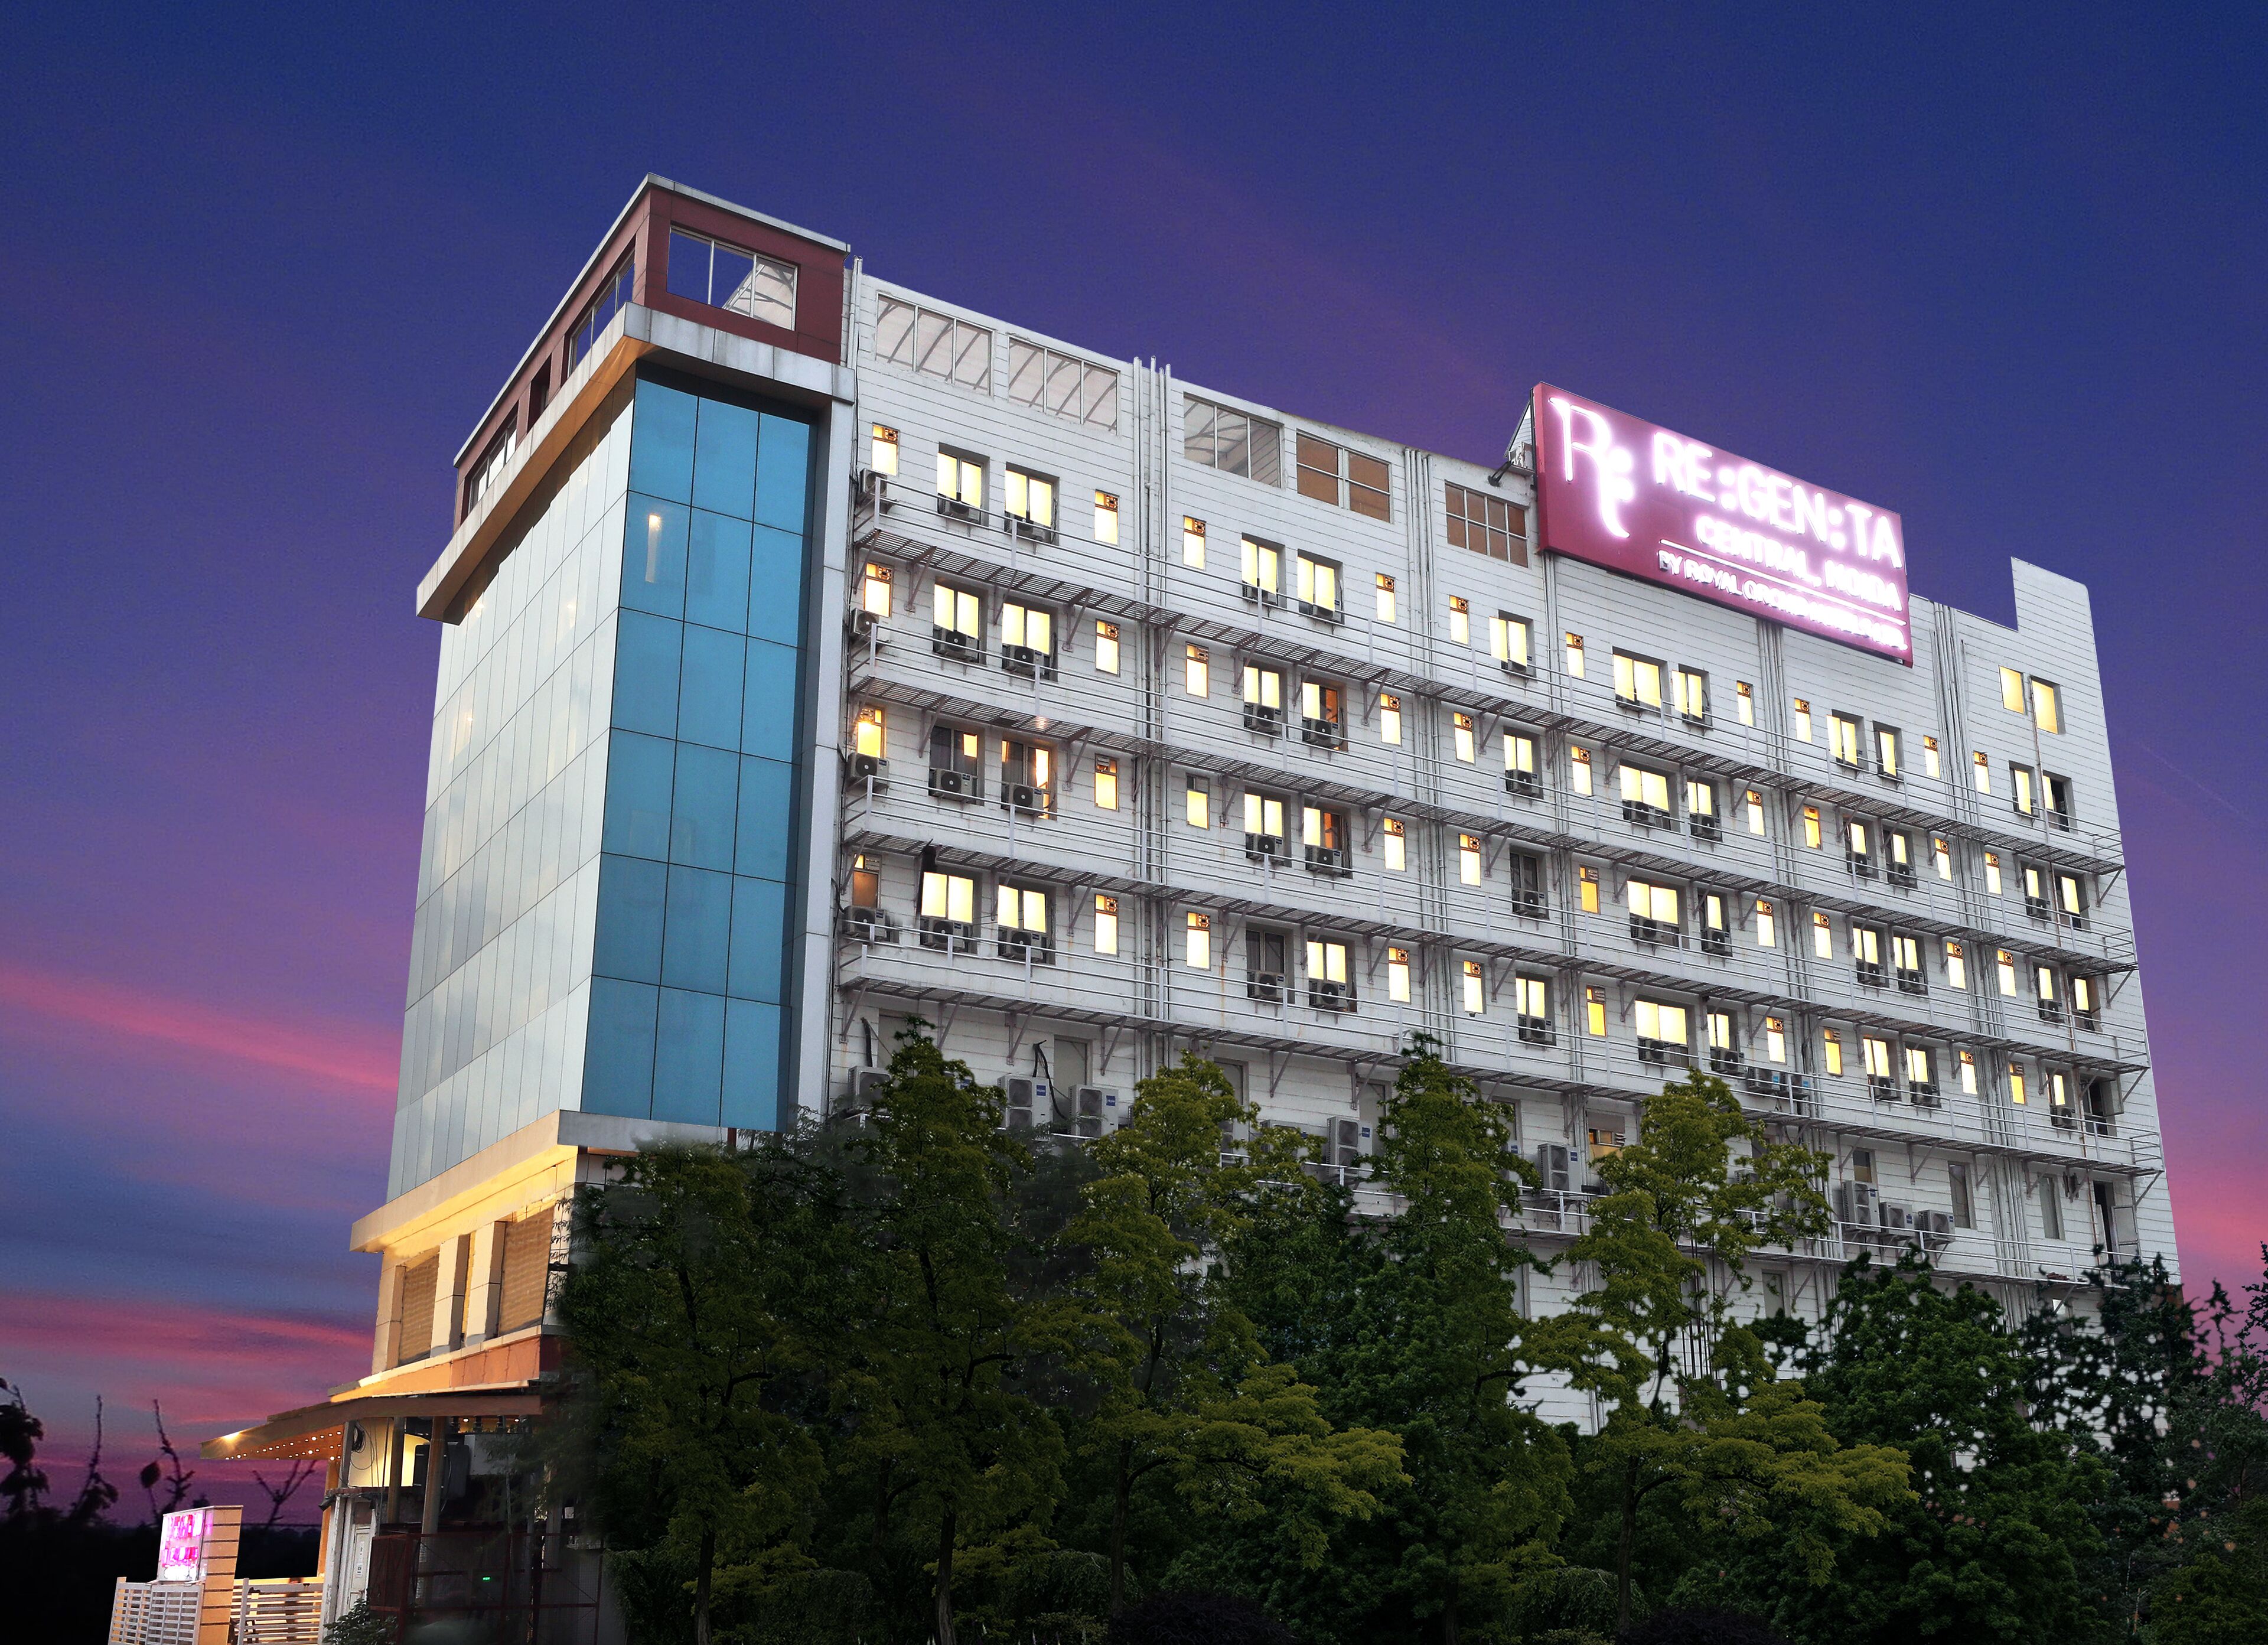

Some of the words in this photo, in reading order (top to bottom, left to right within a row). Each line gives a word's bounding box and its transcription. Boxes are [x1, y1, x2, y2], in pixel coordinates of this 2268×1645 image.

[1657, 549, 1683, 575] BY
[1684, 559, 1742, 595] ROYAL
[1824, 560, 1902, 611] NOIDA
